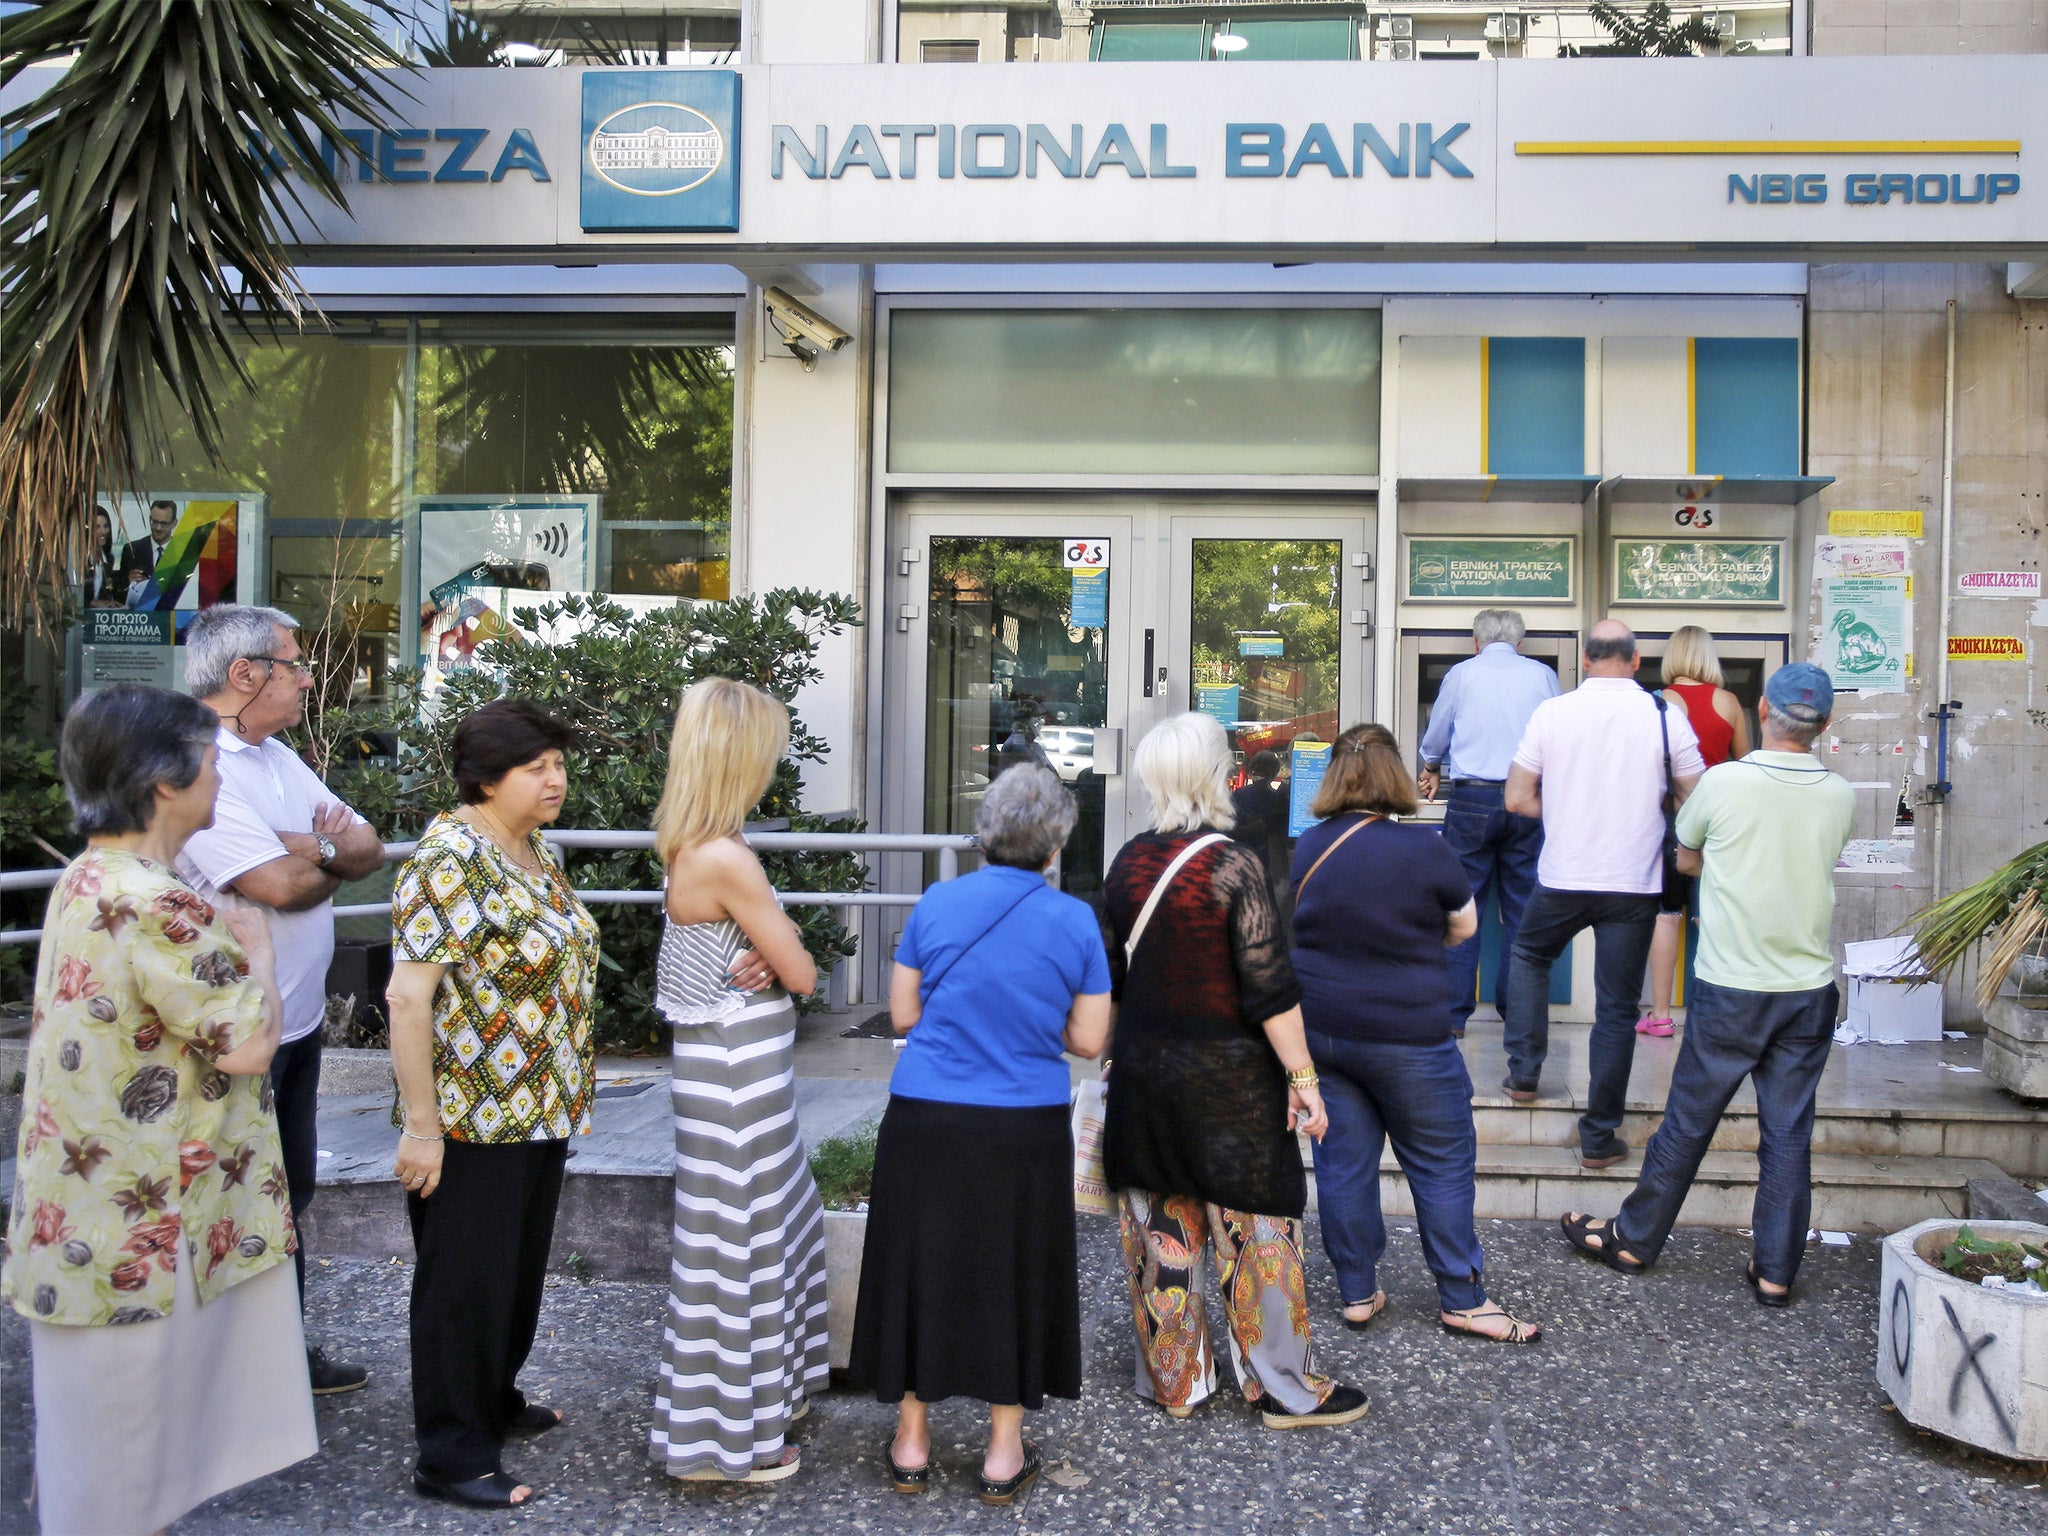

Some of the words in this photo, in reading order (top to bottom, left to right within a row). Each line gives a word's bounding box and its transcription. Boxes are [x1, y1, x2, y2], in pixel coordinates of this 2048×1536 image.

[771, 124, 1196, 179] NATIONAL
[1225, 123, 1474, 178] BANK
[1728, 174, 1828, 204] NBG
[1845, 174, 2020, 204] GROUP
[1675, 506, 1713, 529] G4S
[1067, 543, 1103, 564] G4S
[1503, 561, 1563, 571] ΤΡΑΠΕΖΑ
[1450, 570, 1512, 580] NATIONAL
[1516, 571, 1552, 580] BANK
[1726, 572, 1761, 582] BANK
[95, 613, 109, 624] ΤΟ
[112, 613, 148, 624] ΠΡΩΤΟ
[95, 625, 161, 635] ΠΡΟΓΡΑΜΜΑ
[1948, 639, 2023, 653] ΕΝΟΙΚΙΑΖΕΤΑΙ
